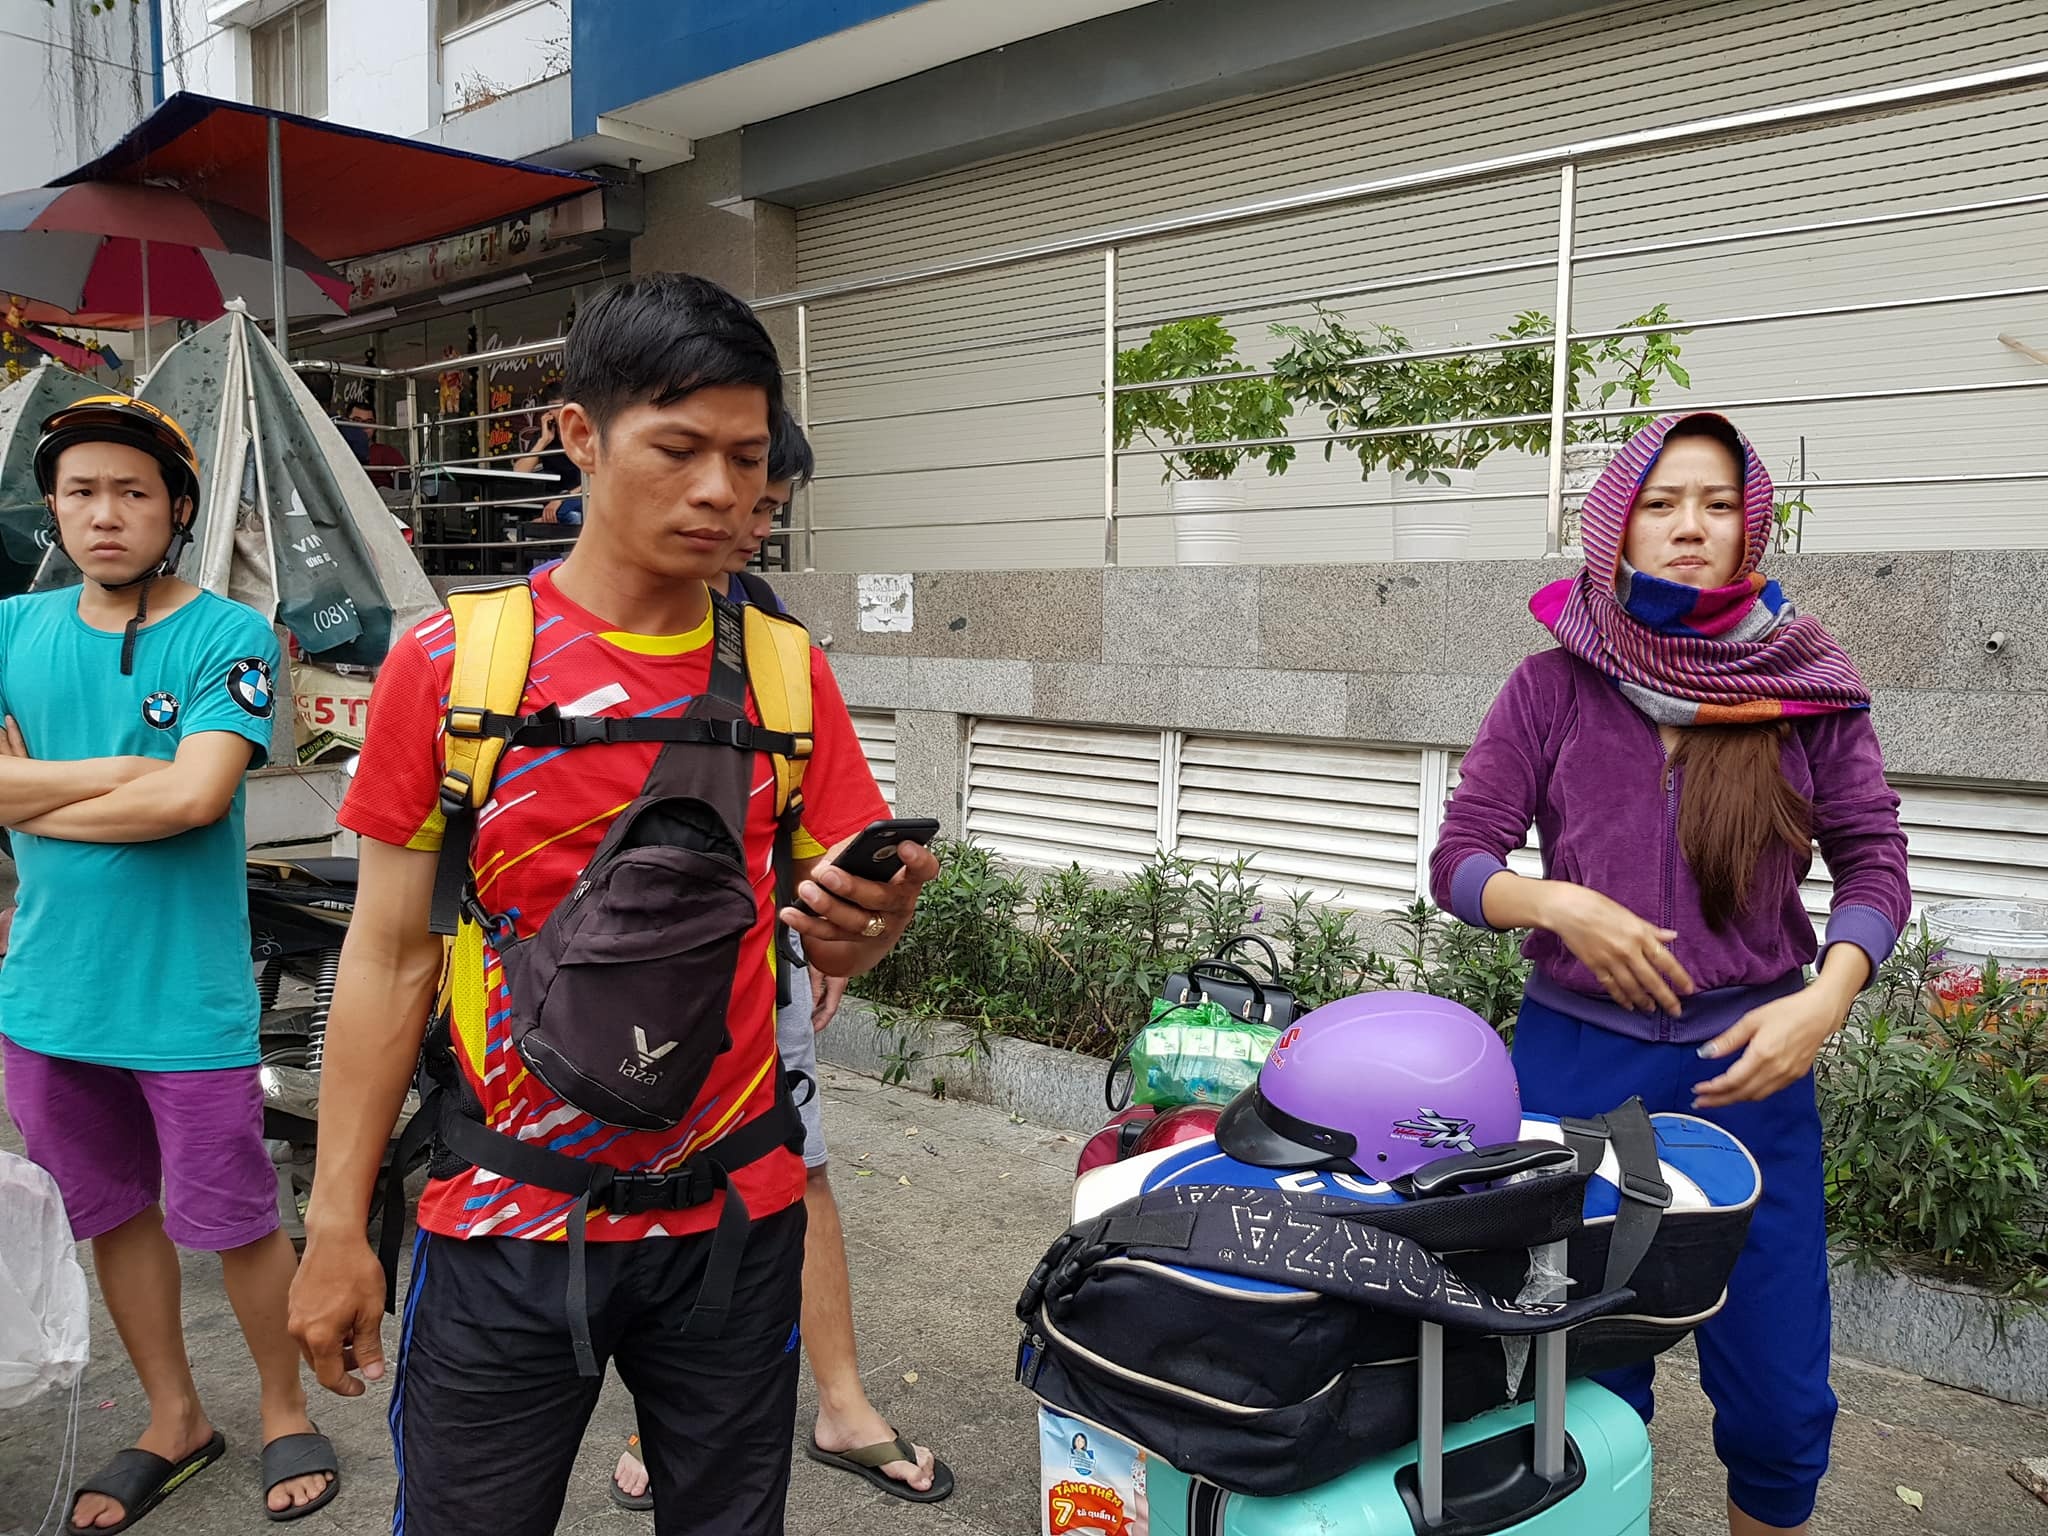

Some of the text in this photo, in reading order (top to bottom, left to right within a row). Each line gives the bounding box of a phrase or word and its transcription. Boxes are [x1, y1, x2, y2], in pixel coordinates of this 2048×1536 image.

[313, 602, 348, 633] (08)
[146, 693, 179, 708] BMW
[618, 1057, 658, 1086] laza
[1088, 1485, 1122, 1507] THÊM
[1053, 1498, 1075, 1526] 7
